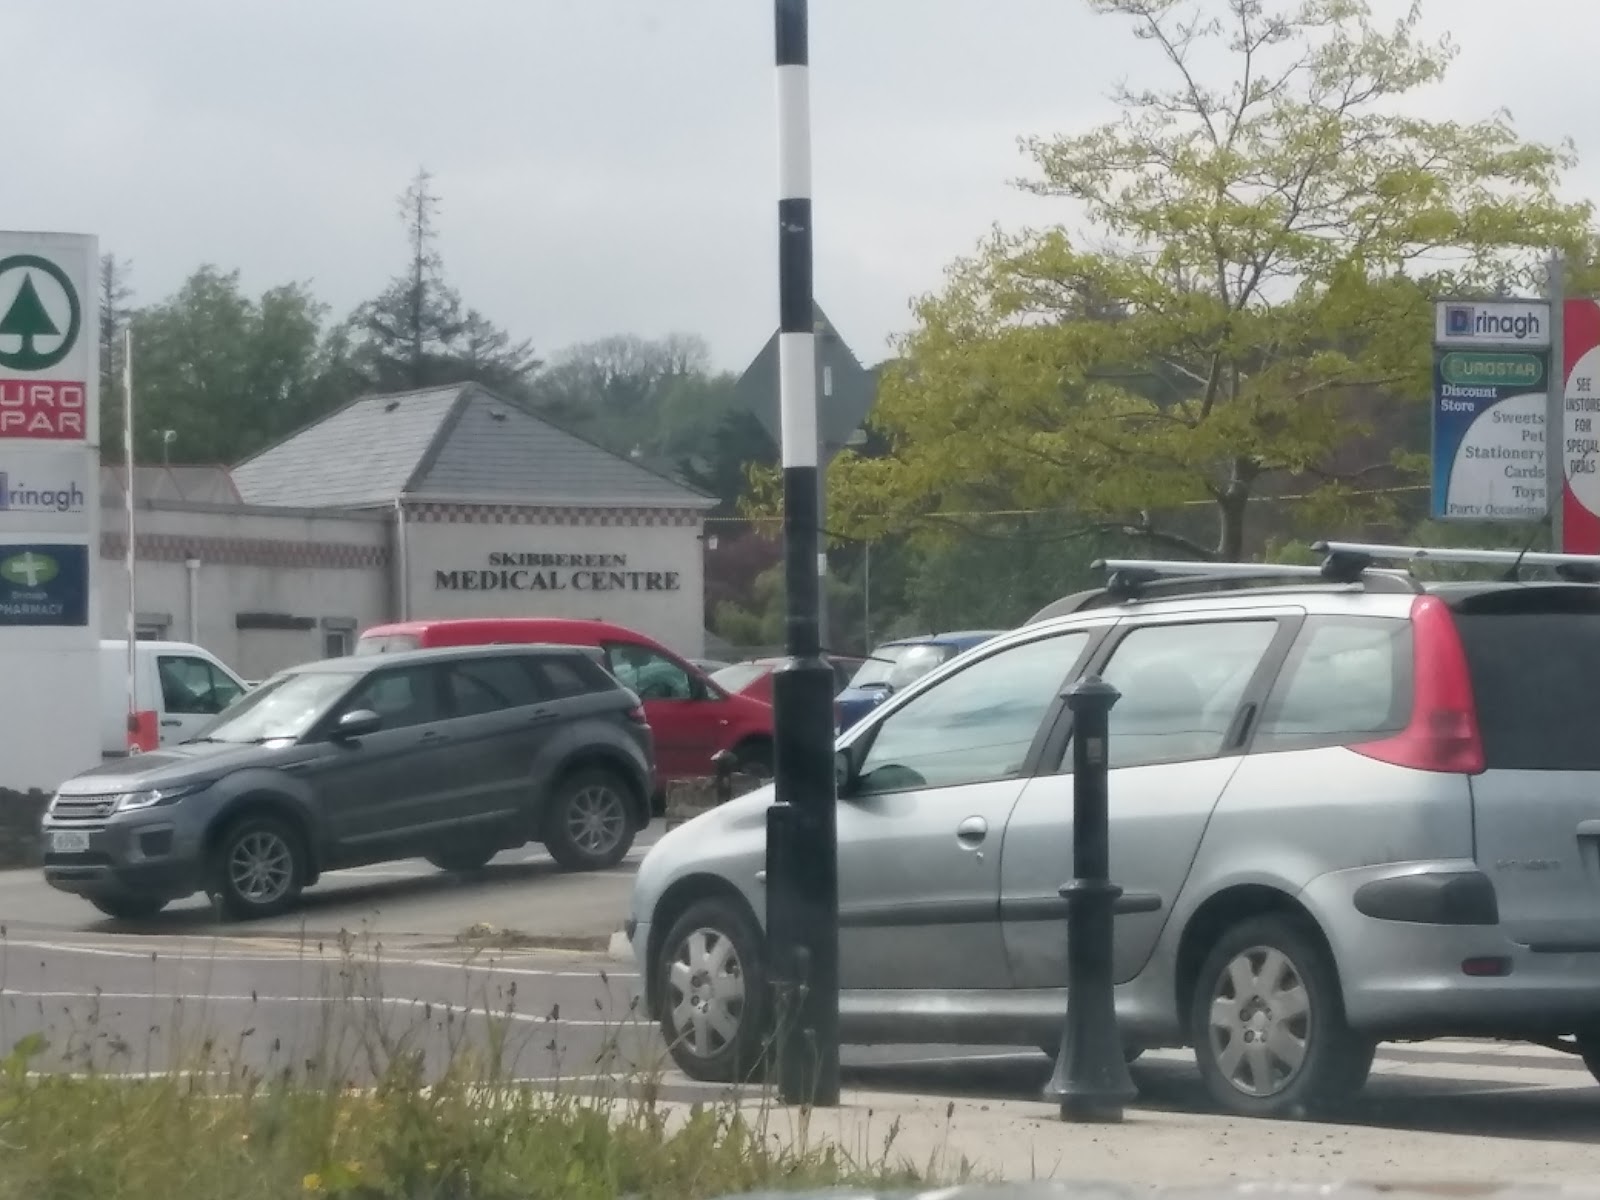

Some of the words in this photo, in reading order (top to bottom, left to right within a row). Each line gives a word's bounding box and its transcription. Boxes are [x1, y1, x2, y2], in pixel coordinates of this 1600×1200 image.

[1448, 308, 1540, 338] Drinagh
[1441, 384, 1498, 398] Discount
[1576, 377, 1592, 392] SEE
[1440, 400, 1475, 412] Store
[1493, 411, 1545, 424] Sweets
[1574, 418, 1592, 432] FOR
[1522, 430, 1545, 442] Pet
[1566, 440, 1600, 453] SPECIAL
[1465, 446, 1545, 463] Stationery
[1504, 465, 1546, 479] Cards
[1570, 460, 1596, 473] DEALS
[1512, 485, 1546, 500] Toys
[1450, 504, 1481, 516] Party
[488, 552, 627, 567] SKIBBEREEN
[435, 570, 566, 591] MEDICAL
[571, 571, 681, 591] CENTRE
